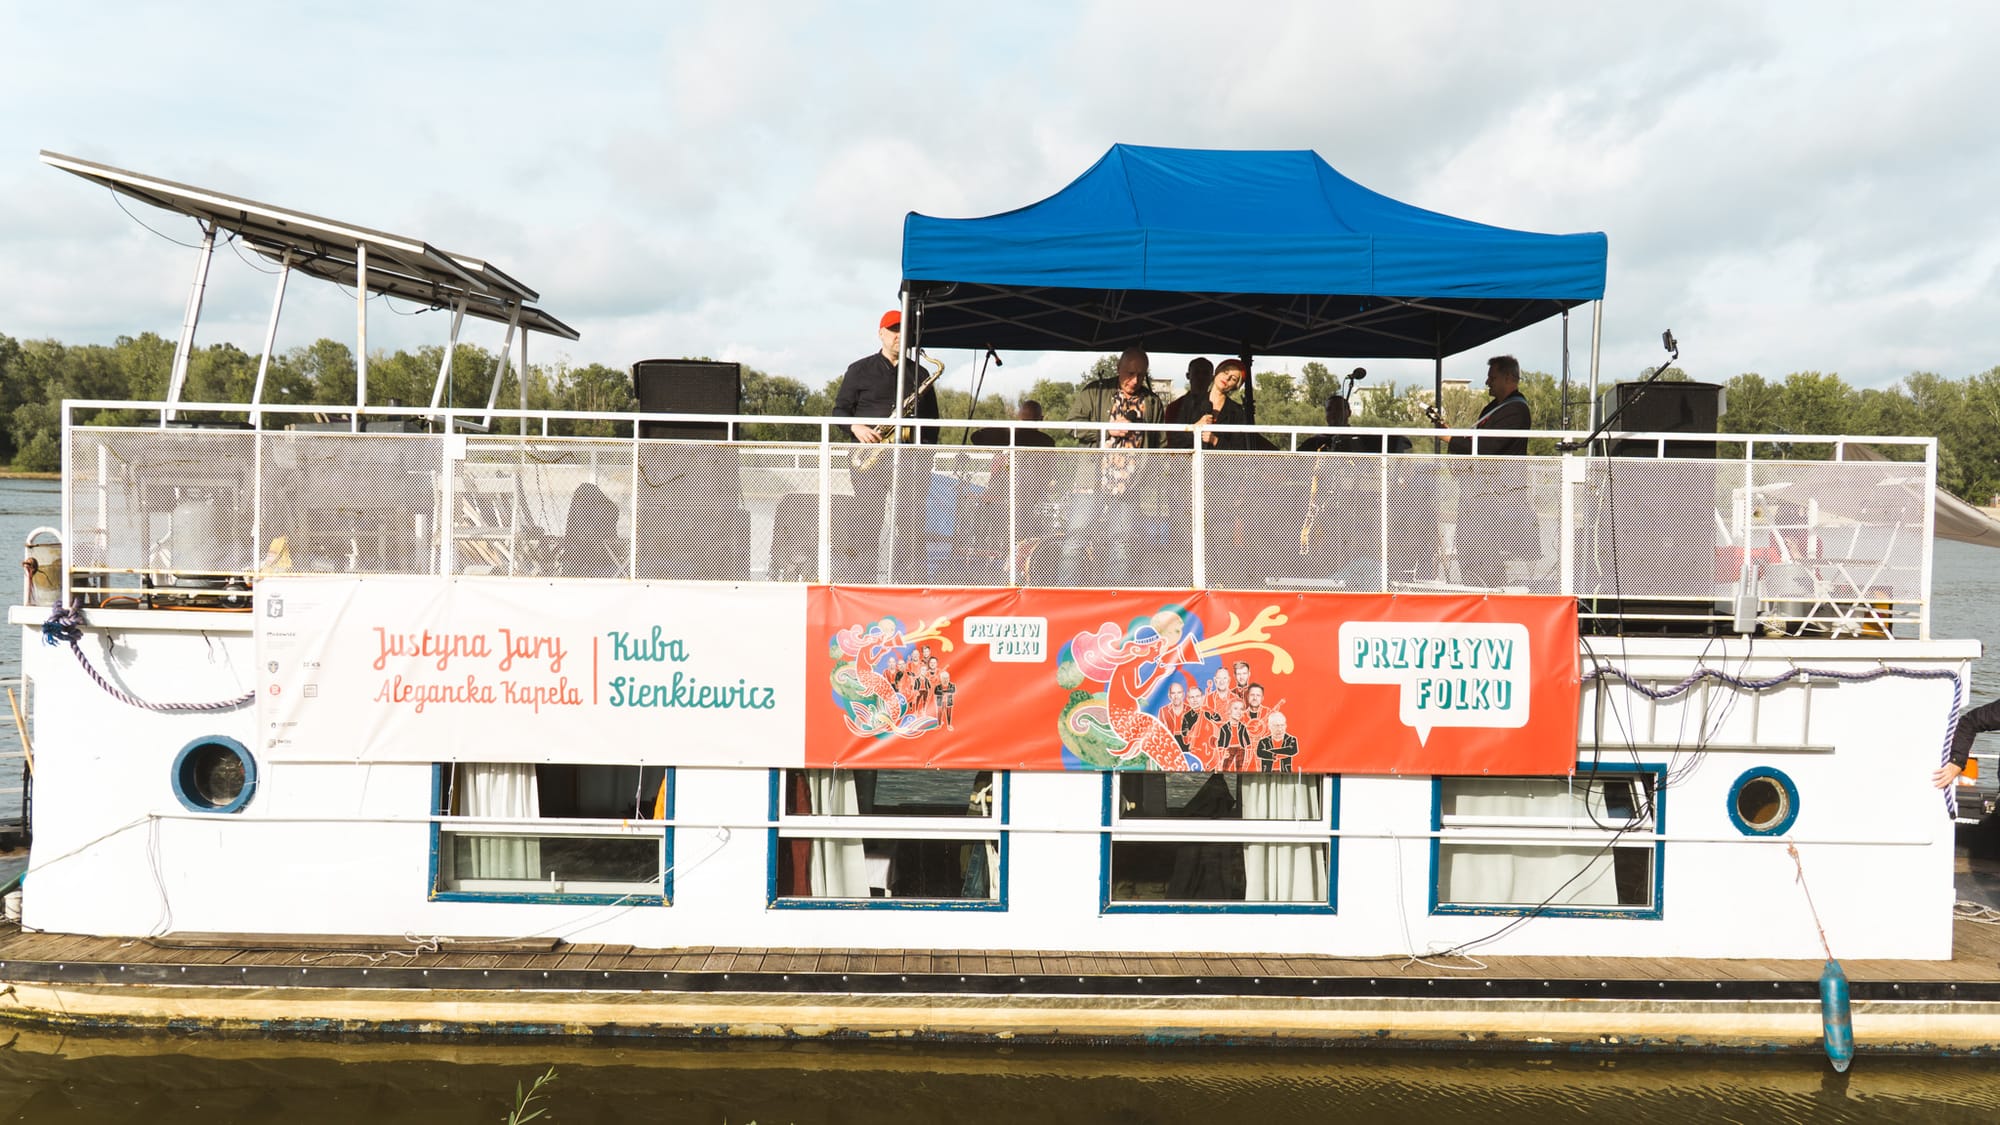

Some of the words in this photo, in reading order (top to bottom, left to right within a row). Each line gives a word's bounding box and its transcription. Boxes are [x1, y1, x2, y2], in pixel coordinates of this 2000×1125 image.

[607, 625, 690, 662] Kuba
[970, 623, 1040, 638] PRZYPŁYW
[996, 641, 1040, 655] FOLKU
[372, 626, 492, 672] Justyna
[498, 627, 568, 674] Jary
[1352, 636, 1514, 670] PRZYPŁYW
[373, 674, 497, 714] Alegancka
[499, 677, 584, 714] Kapela
[608, 671, 776, 709] Sienkiewicz
[1415, 677, 1512, 710] FOLKU
